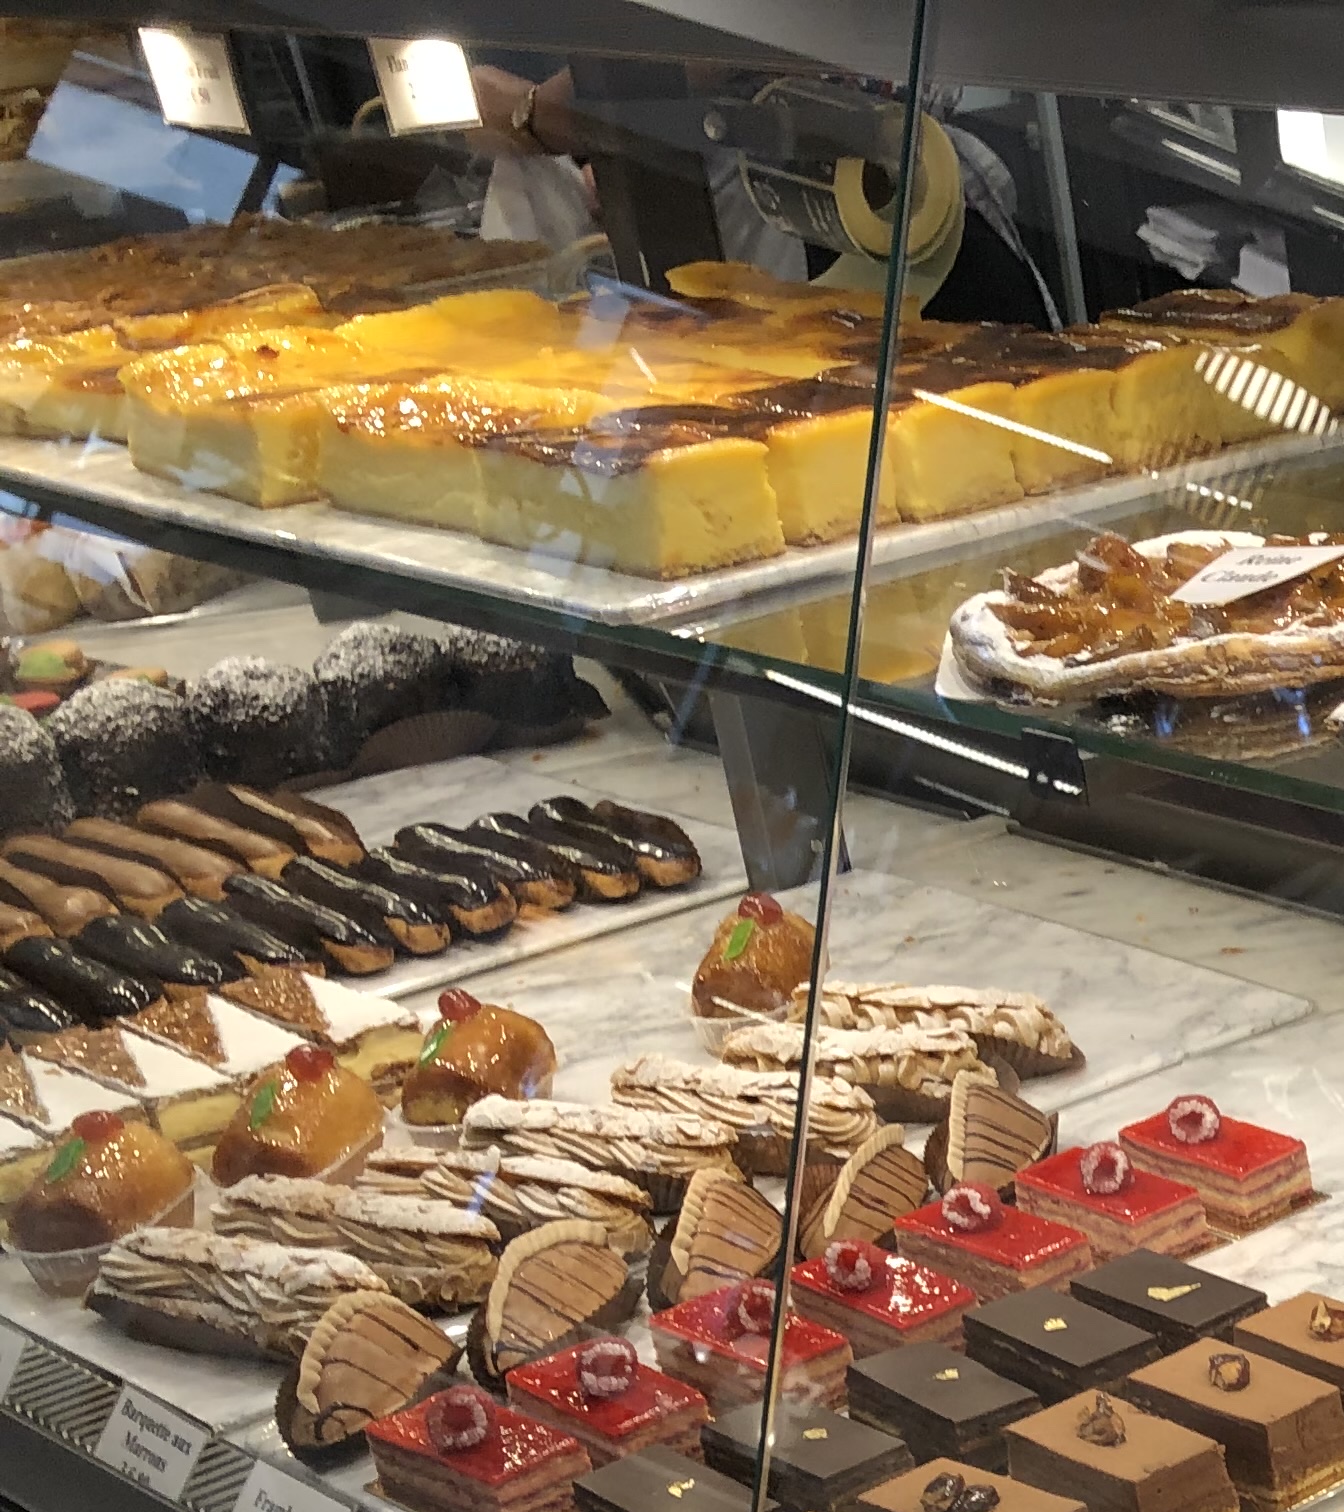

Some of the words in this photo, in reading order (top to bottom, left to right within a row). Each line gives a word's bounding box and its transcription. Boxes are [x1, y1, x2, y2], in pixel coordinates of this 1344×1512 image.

[121, 1398, 170, 1441] Barquette
[171, 1434, 192, 1455] aux
[124, 1430, 168, 1473] Marrons
